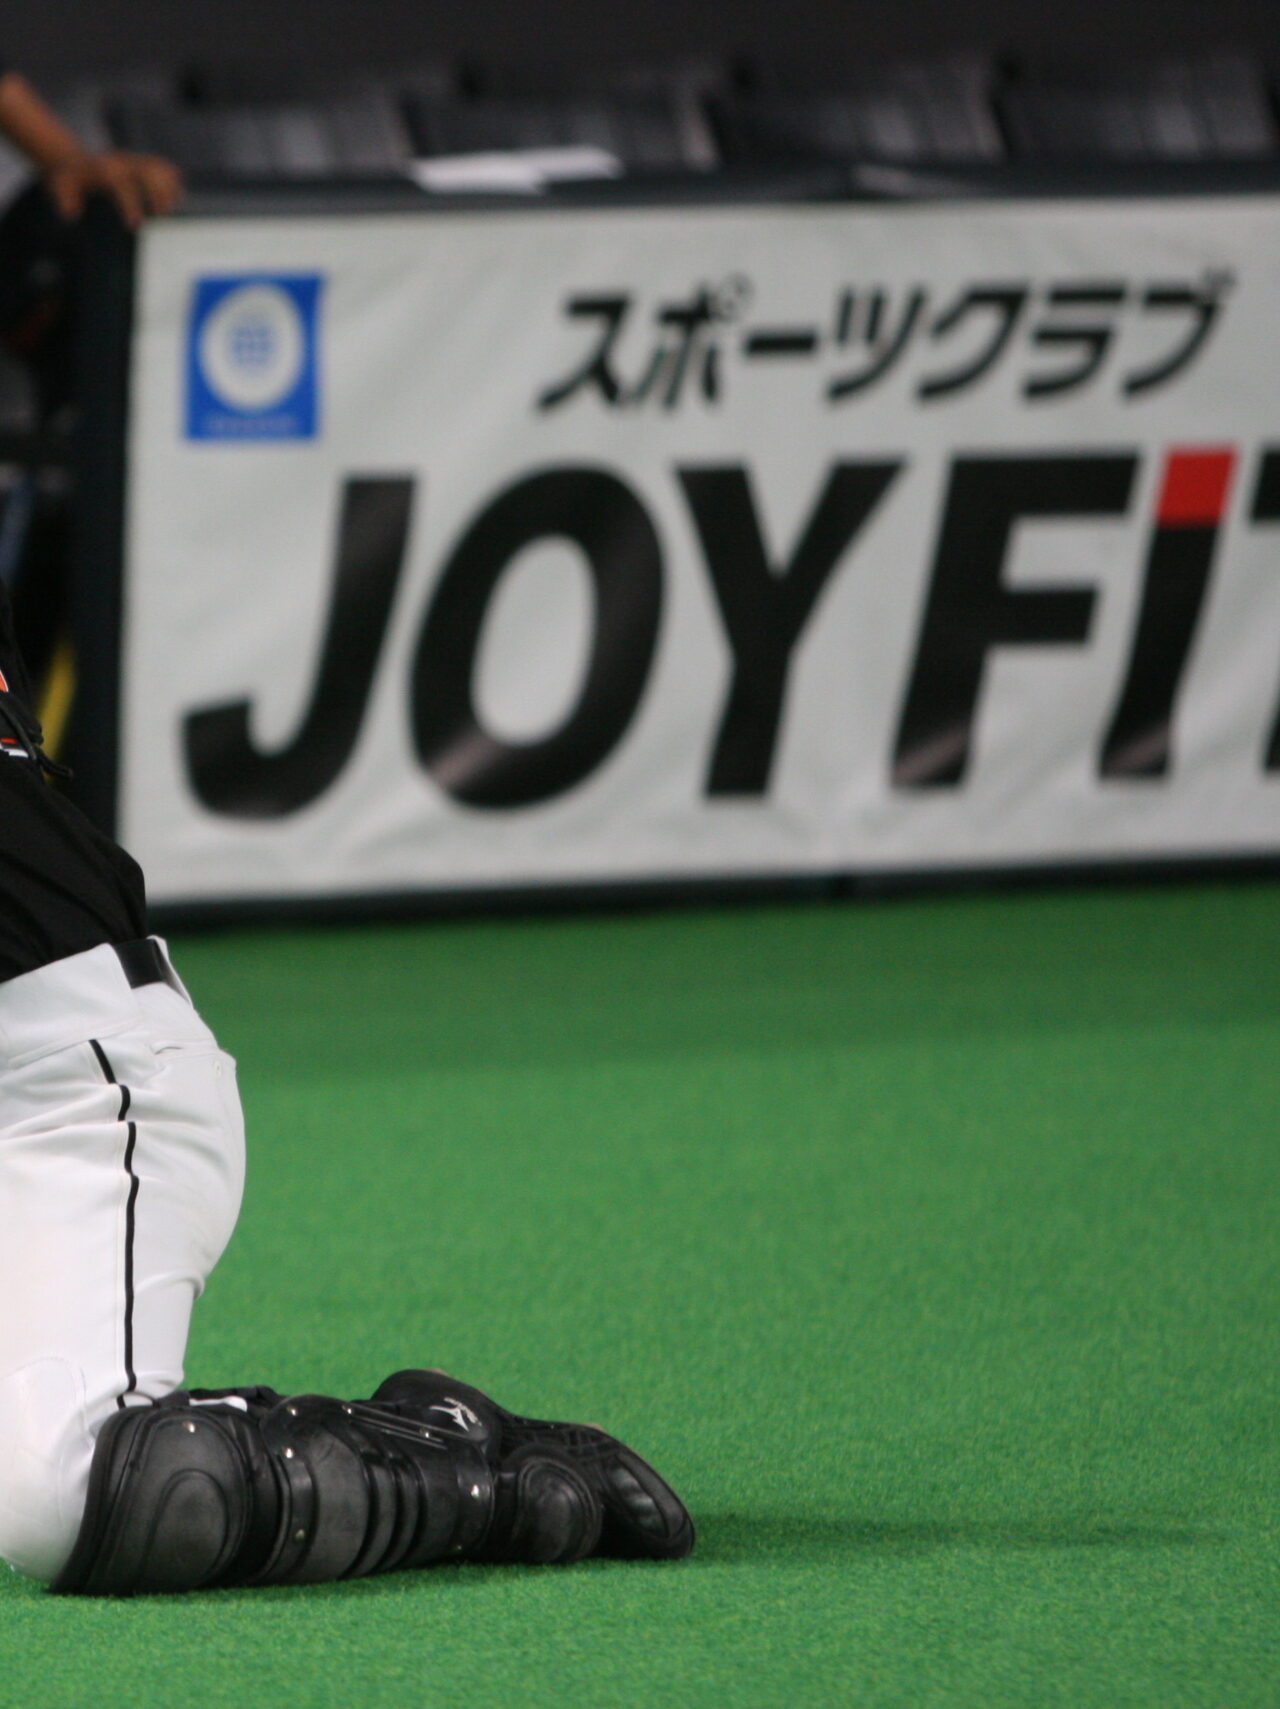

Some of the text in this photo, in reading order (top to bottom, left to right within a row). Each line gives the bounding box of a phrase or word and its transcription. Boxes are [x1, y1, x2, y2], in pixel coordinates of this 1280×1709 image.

[538, 265, 1236, 413] スポーツクラブ
[180, 443, 1280, 822] JOYFI
